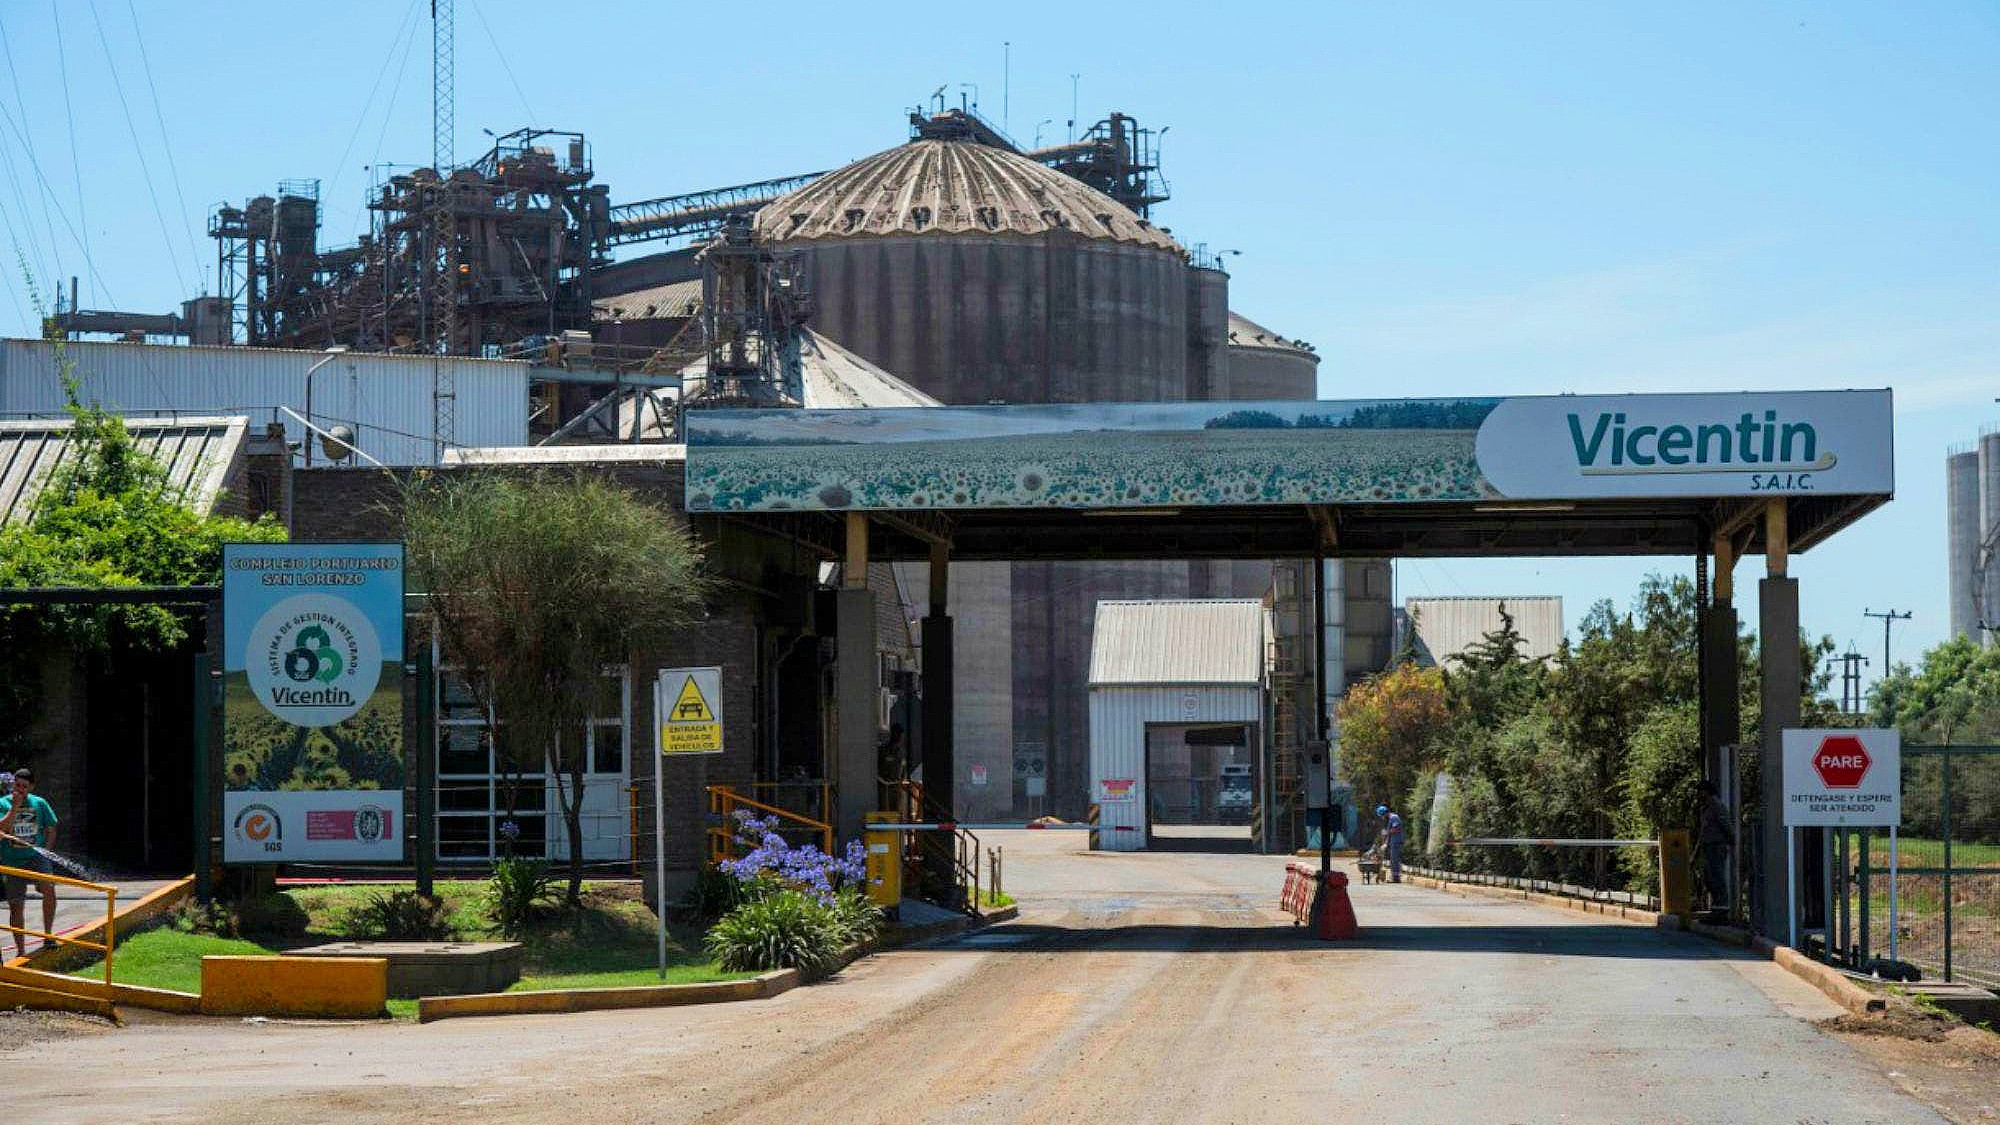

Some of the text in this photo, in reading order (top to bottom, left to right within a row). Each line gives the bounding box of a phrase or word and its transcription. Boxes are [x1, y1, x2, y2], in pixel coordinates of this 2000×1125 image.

[1567, 410, 1817, 466] Vicentin
[1750, 474, 1814, 490] S.A.I.C.
[231, 557, 398, 570] COMPLEJO PORTUARIO
[262, 573, 366, 586] SAN LORENZO
[280, 621, 293, 635] DE
[272, 687, 350, 704] Vicentin
[671, 725, 706, 733] ENTRADA
[1821, 755, 1864, 769] PARE
[1791, 794, 1847, 803] DETENGASE
[1857, 793, 1893, 803] ESPERE
[1809, 804, 1876, 812] SER ATENDIDO
